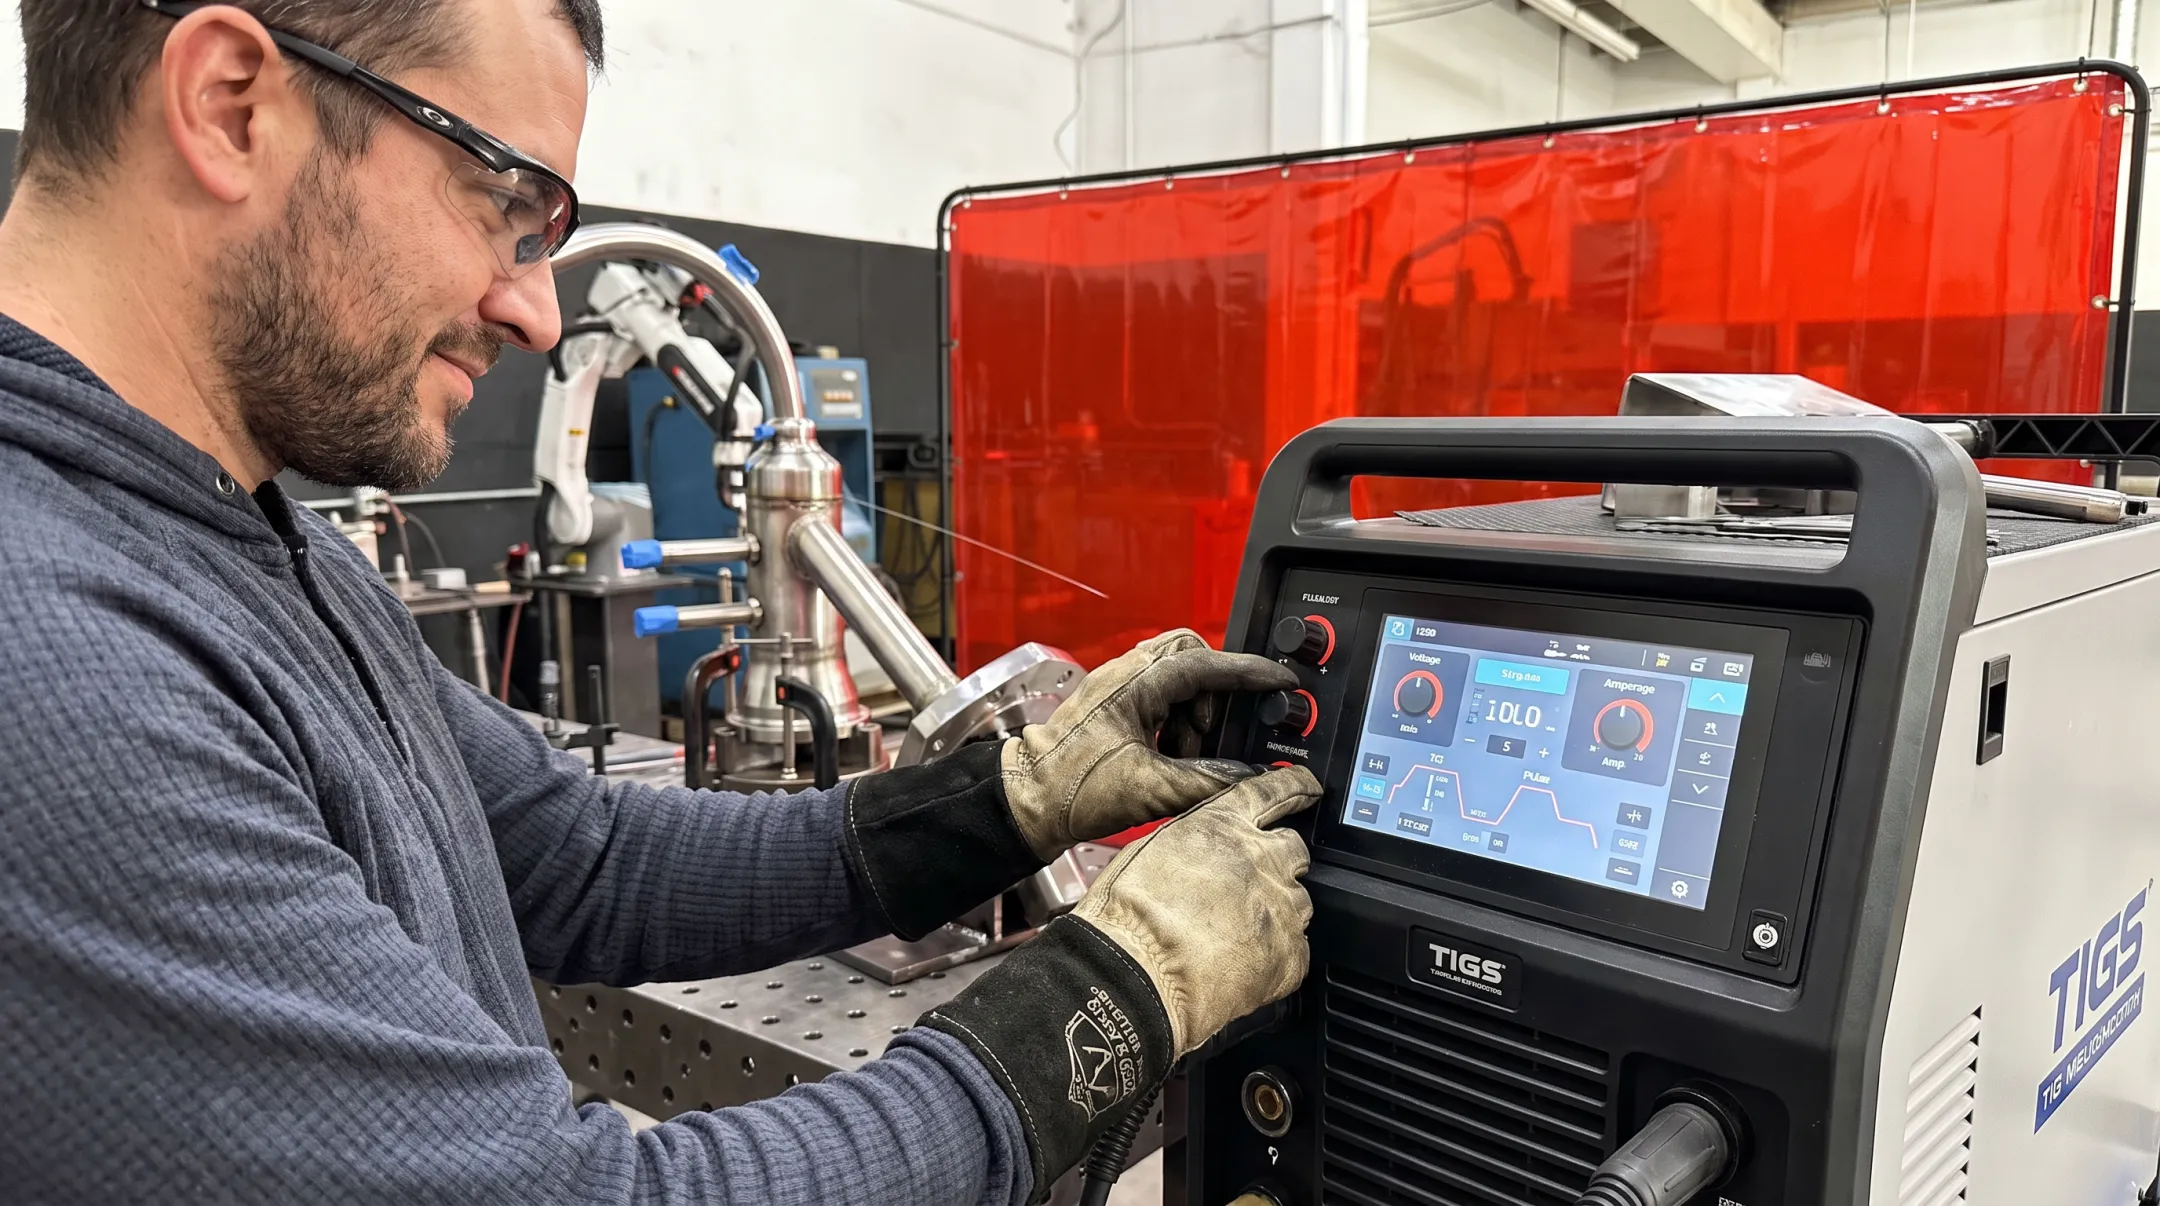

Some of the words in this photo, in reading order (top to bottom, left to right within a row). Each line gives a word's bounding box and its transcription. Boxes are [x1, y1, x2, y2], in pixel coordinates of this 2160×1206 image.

[1603, 678, 1656, 695] Amperage
[1429, 943, 1502, 984] TIGS
[2048, 887, 2147, 1054] TIGS
[2042, 1073, 2063, 1111] TIG
